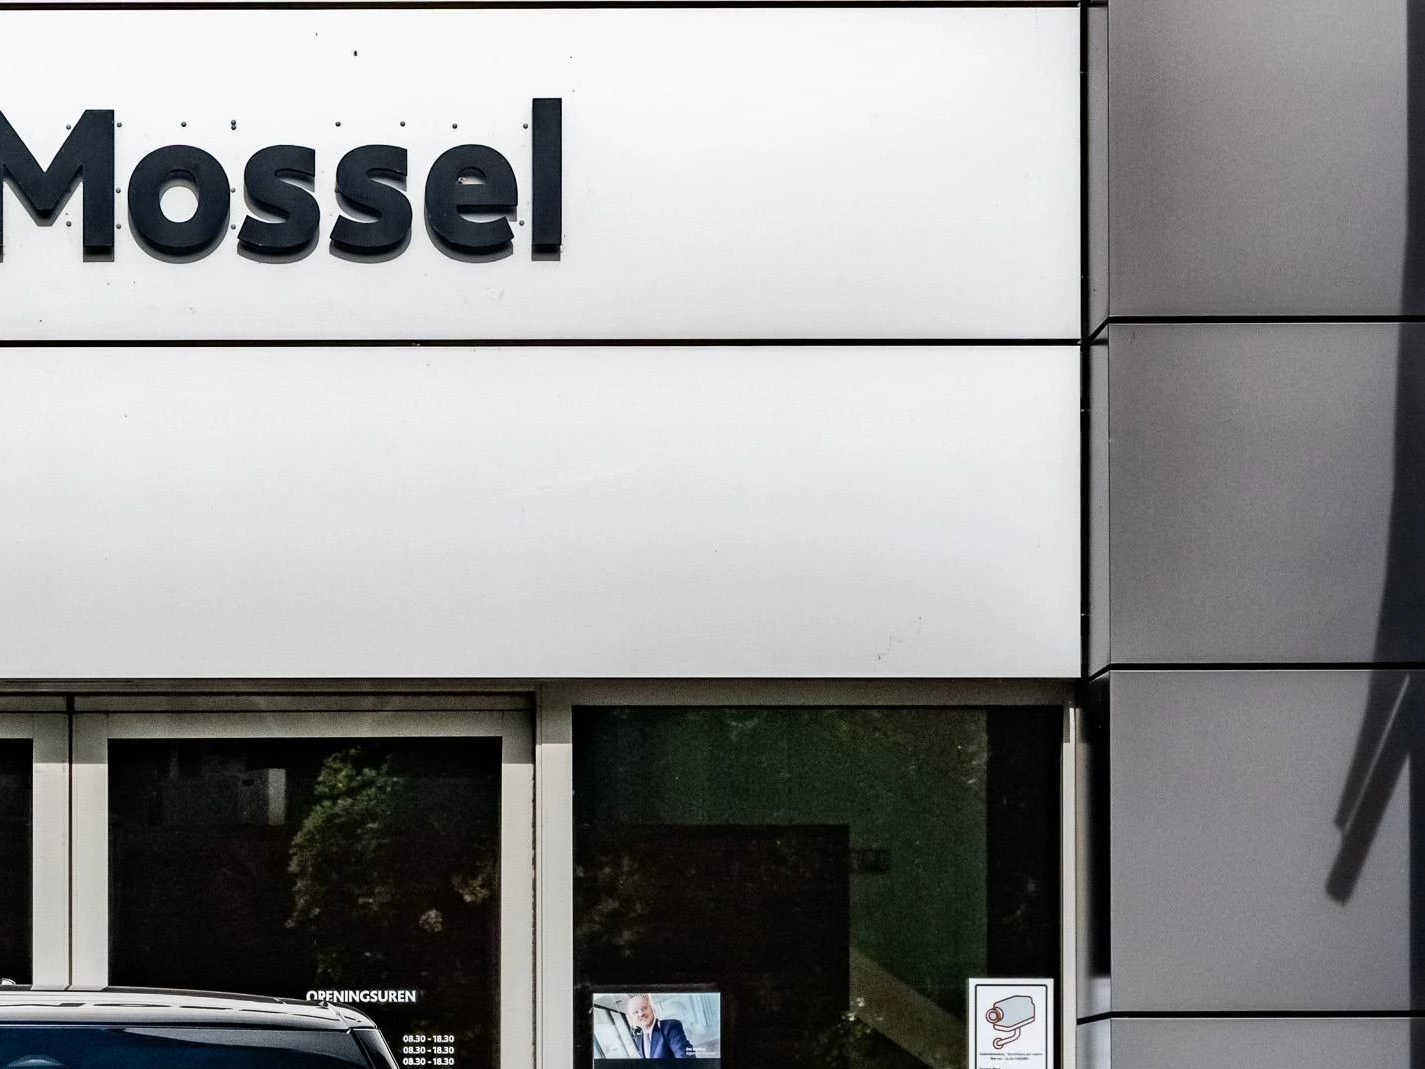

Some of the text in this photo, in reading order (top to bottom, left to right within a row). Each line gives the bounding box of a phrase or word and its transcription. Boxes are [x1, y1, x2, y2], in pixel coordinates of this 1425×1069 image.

[306, 989, 417, 1003] OPENINGSUREN
[402, 1035, 426, 1043] 08.30
[432, 1035, 455, 1043] 18.30
[402, 1046, 426, 1054] 08.30
[432, 1046, 455, 1054] 18.30
[402, 1057, 426, 1066] 08.30
[432, 1057, 455, 1066] 18.30
